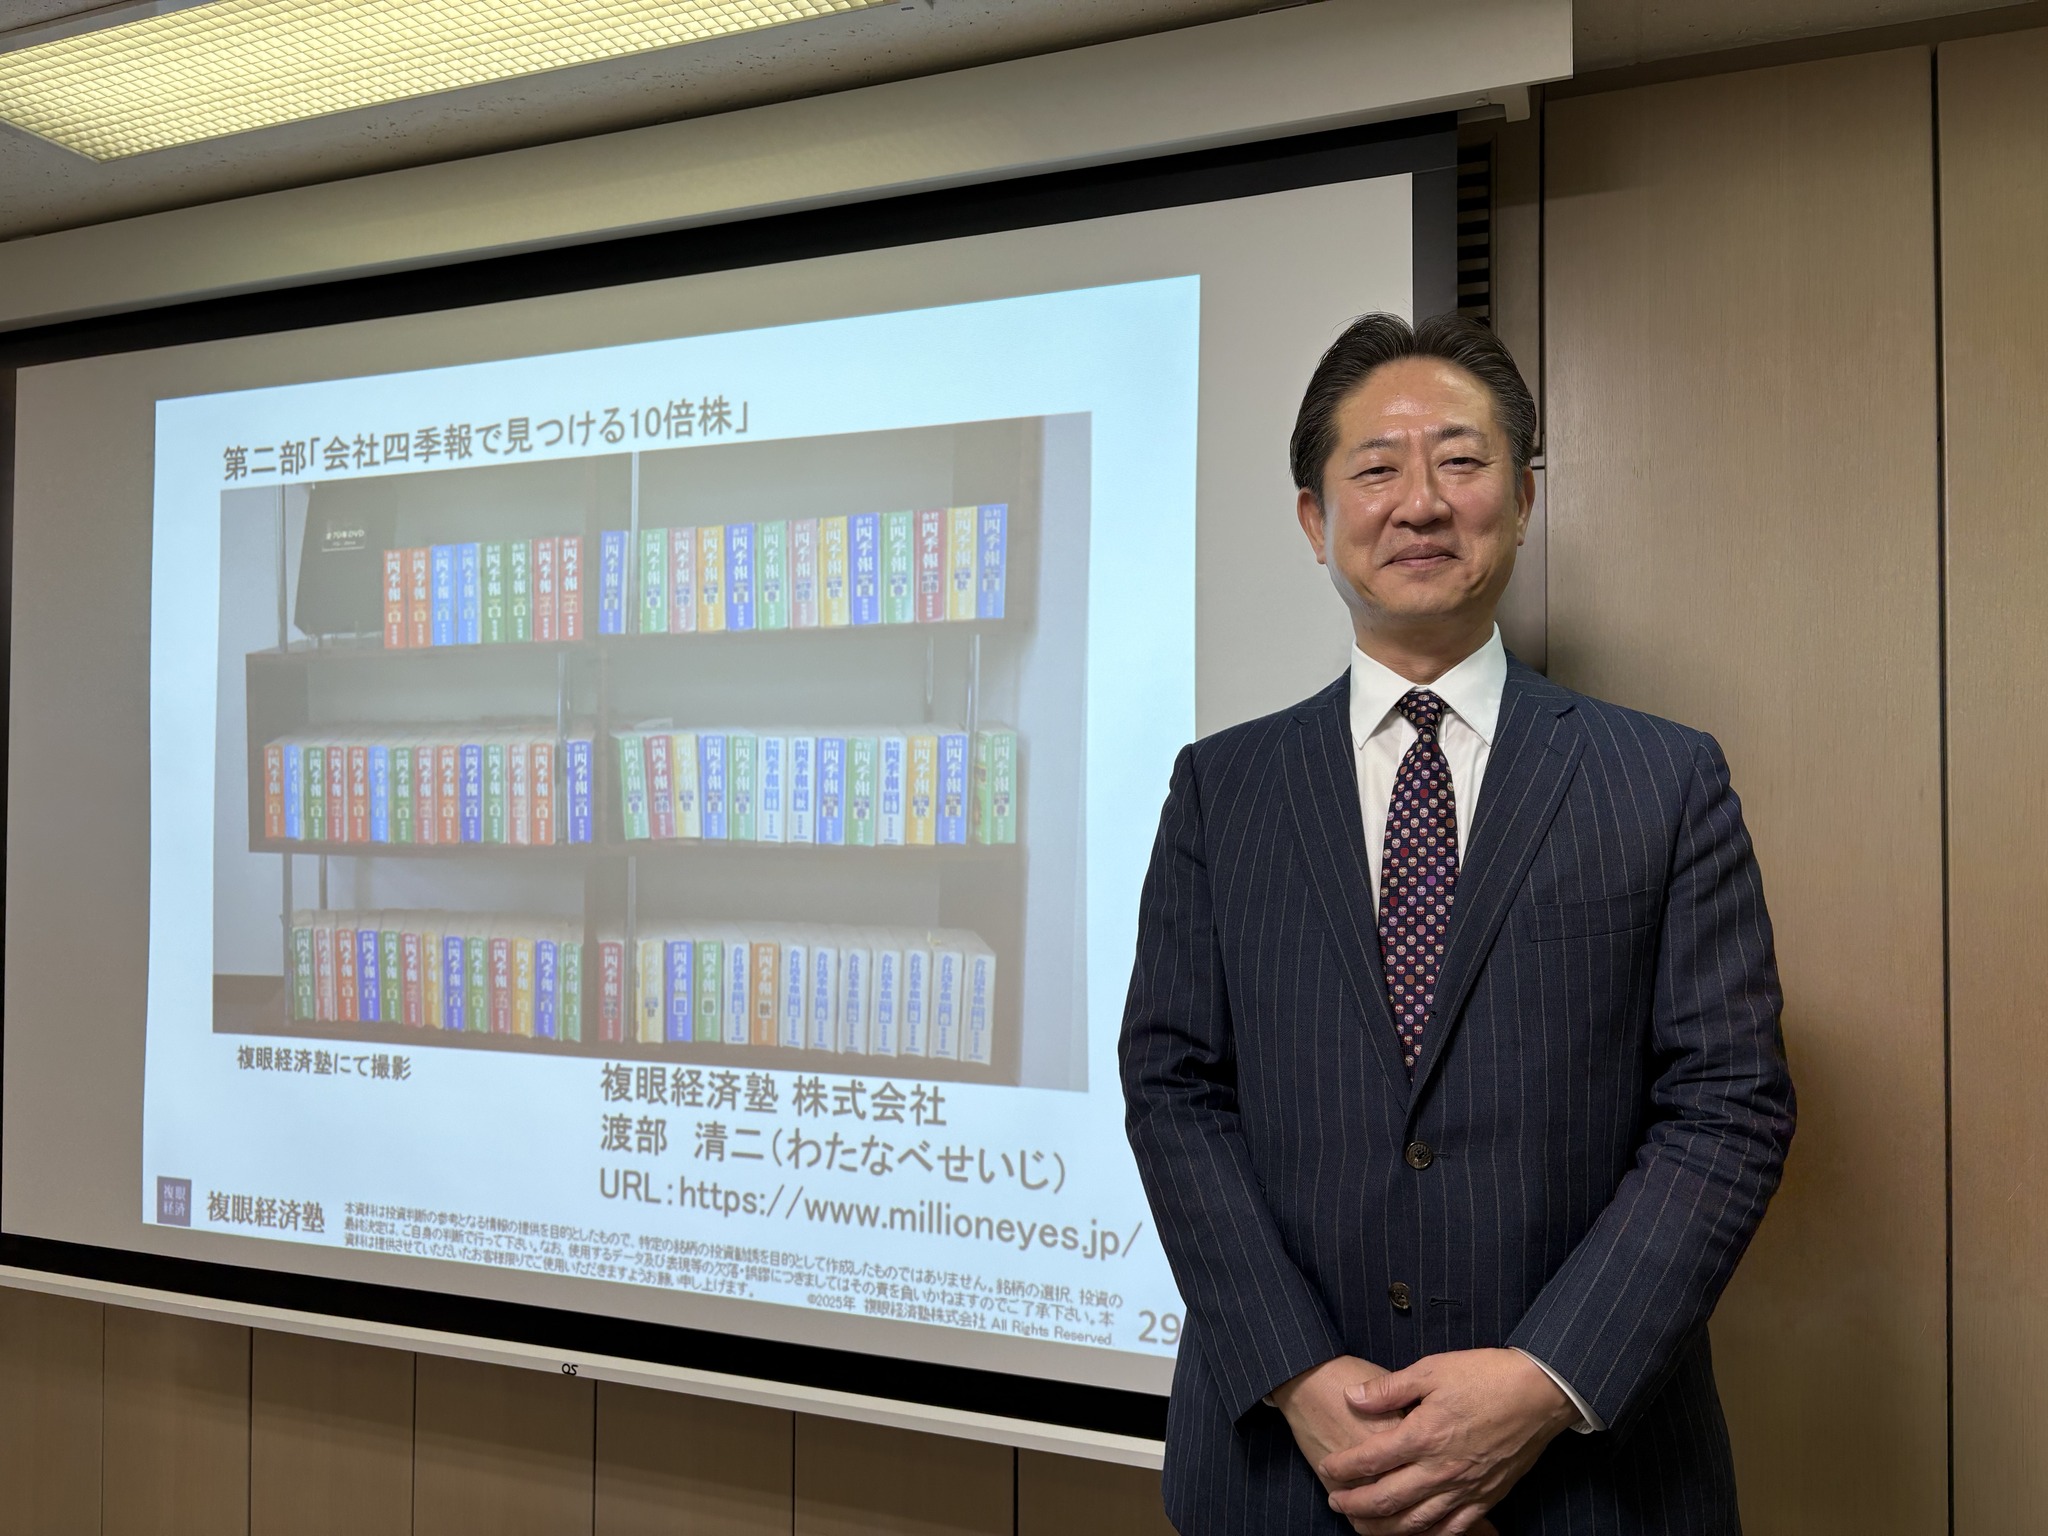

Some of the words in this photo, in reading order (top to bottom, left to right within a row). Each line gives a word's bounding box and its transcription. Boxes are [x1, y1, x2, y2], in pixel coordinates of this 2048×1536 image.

[223, 395, 748, 481] 第二部「会社四季報で見つける10倍株」
[237, 1044, 412, 1081] 複眼経済塾にて撮影
[600, 1062, 778, 1114] 複眼経済塾
[792, 1074, 947, 1127] 株式会社
[600, 1112, 667, 1156] 渡部
[207, 1190, 326, 1234] 複眼経済塾
[991, 1317, 1008, 1331] All
[1012, 1320, 1049, 1337] Rights
[1138, 1309, 1181, 1345] 29
